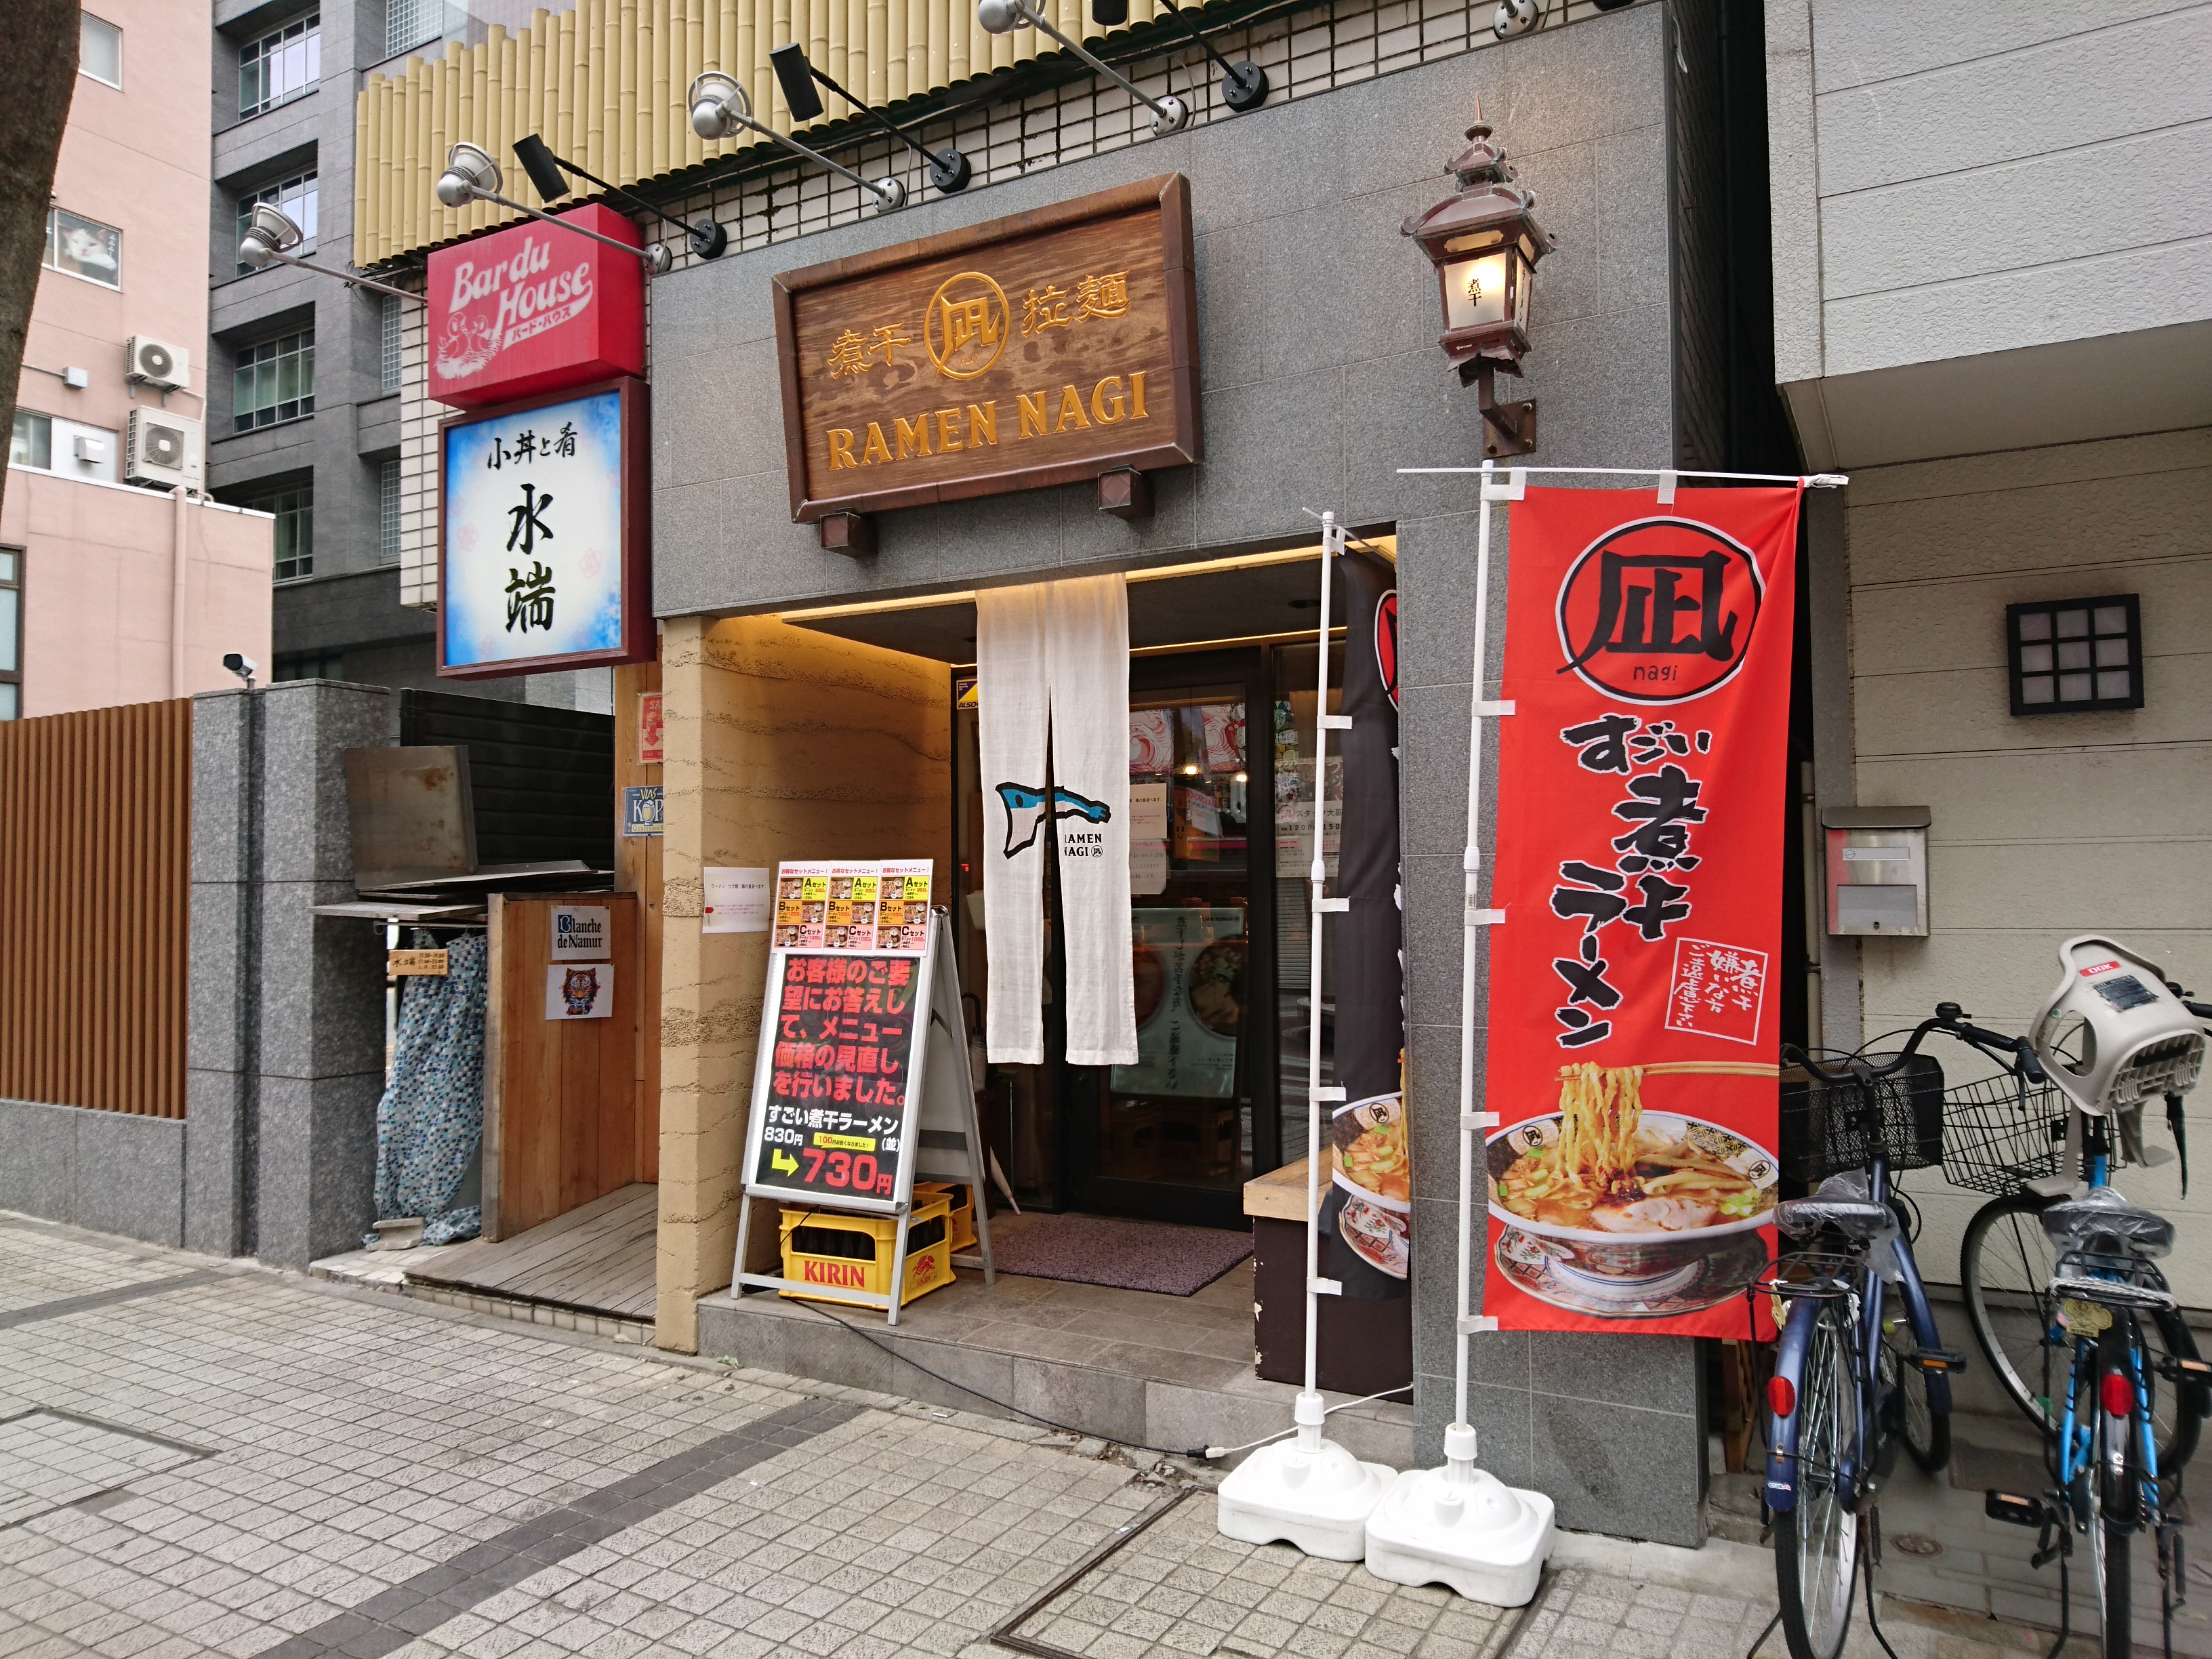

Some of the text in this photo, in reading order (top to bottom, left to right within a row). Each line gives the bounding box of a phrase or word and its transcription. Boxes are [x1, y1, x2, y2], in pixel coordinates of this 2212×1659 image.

[491, 262, 590, 337] House
[1467, 279, 1482, 306] 煮干
[827, 321, 913, 379] 煮干
[826, 371, 1149, 471] RAMEN NAGI
[1556, 550, 1738, 674] 凪
[1633, 664, 1677, 681] nagi
[649, 700, 663, 710] SA
[558, 915, 601, 933] Blanche
[558, 934, 602, 948] de Namur
[786, 958, 911, 986] お客様のご要
[2088, 963, 2113, 974] OGK
[782, 985, 905, 1014] 望にお答えし
[781, 1015, 902, 1042] て、メニュー
[775, 1041, 899, 1073] 価格の見直し
[773, 1071, 905, 1106] を行いました。
[769, 1105, 899, 1134] すごい煮干ラーメン
[764, 1127, 803, 1146] 830円
[803, 1148, 893, 1195] 730円
[804, 1261, 865, 1288] KIRIN
